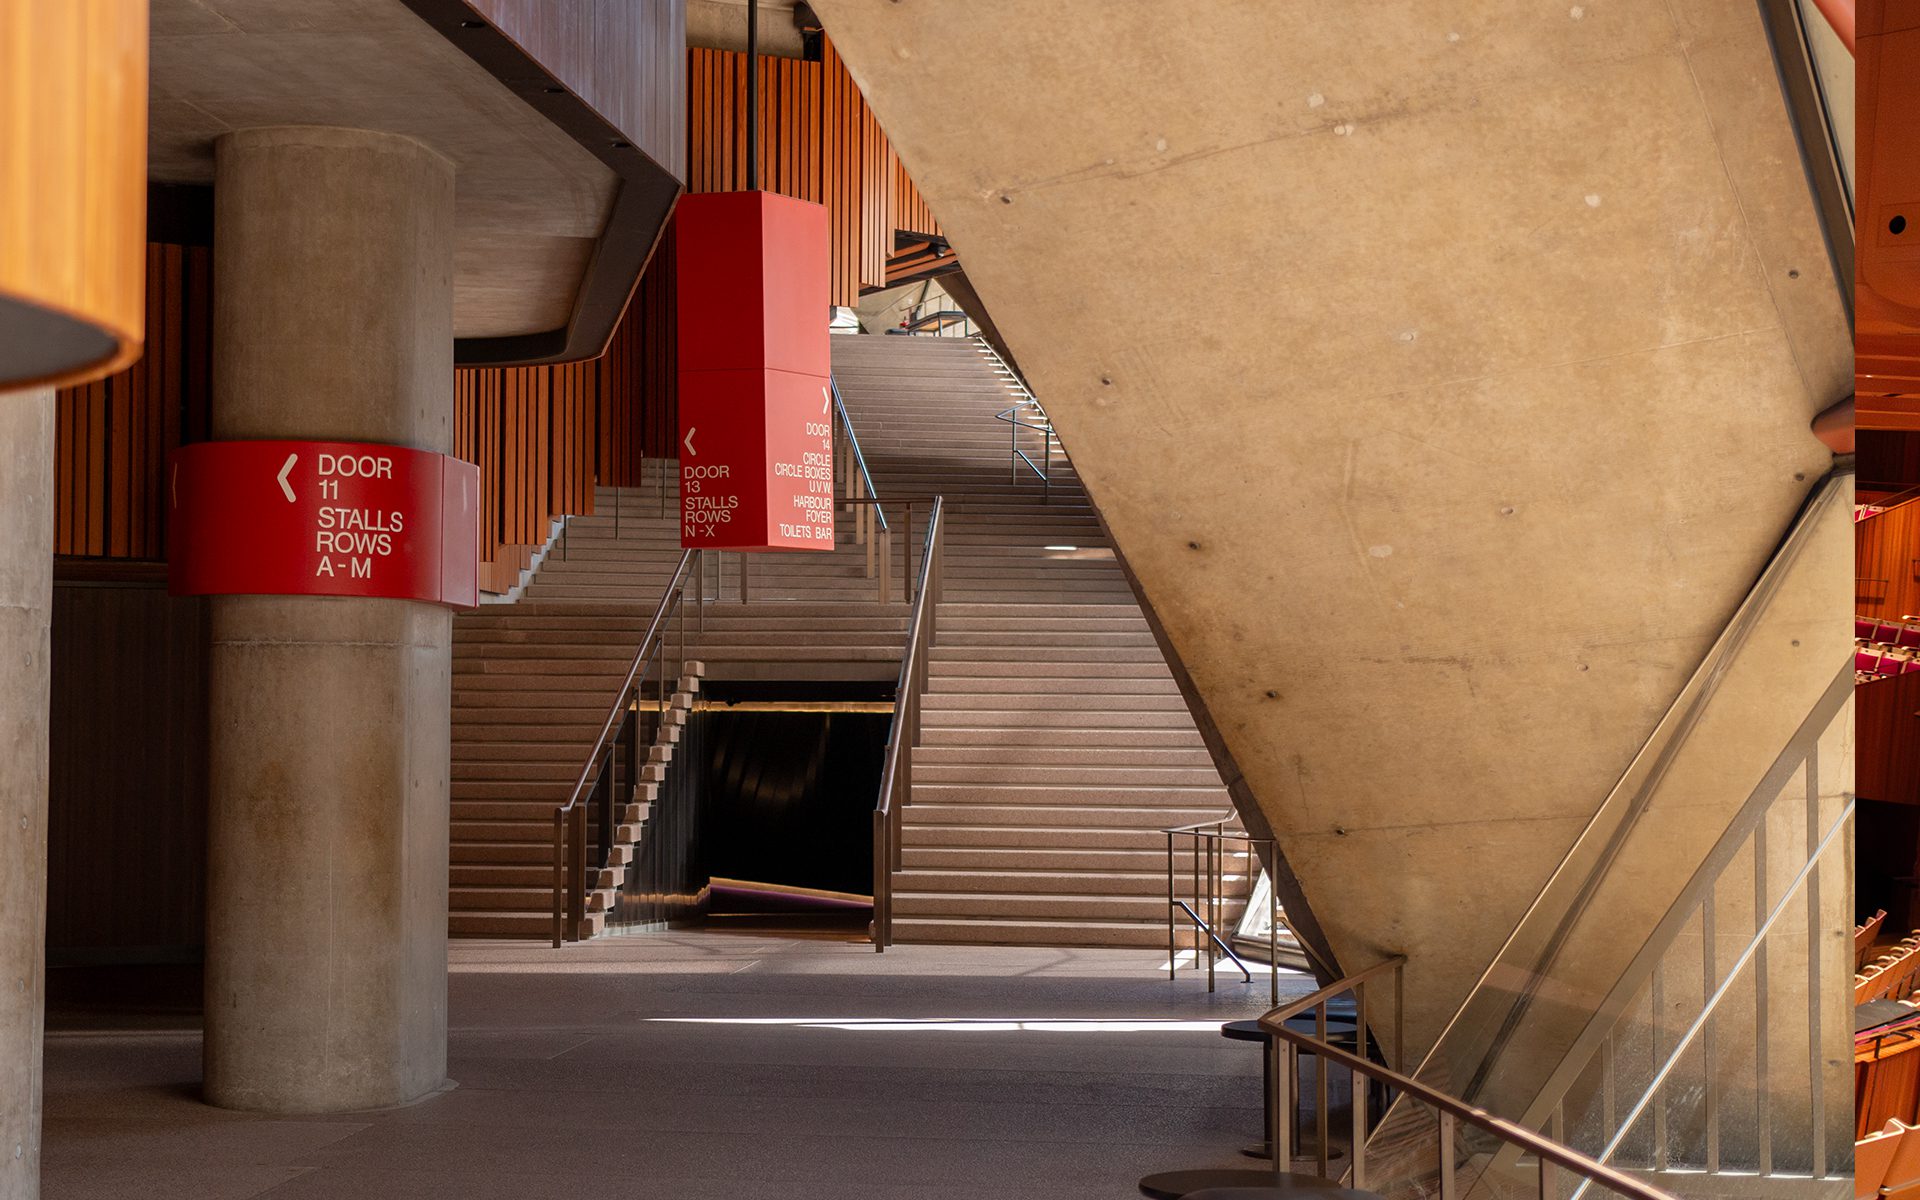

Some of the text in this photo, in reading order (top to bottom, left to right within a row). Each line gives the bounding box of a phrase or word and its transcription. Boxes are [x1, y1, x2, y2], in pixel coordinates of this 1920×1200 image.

[806, 422, 830, 437] DOOR
[822, 439, 830, 451] 14
[318, 454, 393, 479] DOOR
[803, 452, 831, 467] CIRCLE
[684, 465, 730, 479] DOOR
[775, 462, 831, 480] CIRCLE BOXES
[318, 479, 339, 500] 11
[684, 480, 701, 493] 13
[685, 495, 739, 510] STALLS
[793, 495, 832, 510] HARBOUR
[317, 506, 403, 533] STALLS
[685, 509, 731, 524] ROWS
[806, 509, 832, 524] FOYER
[779, 523, 832, 540] TOILETS BAR
[316, 530, 392, 556] ROWS
